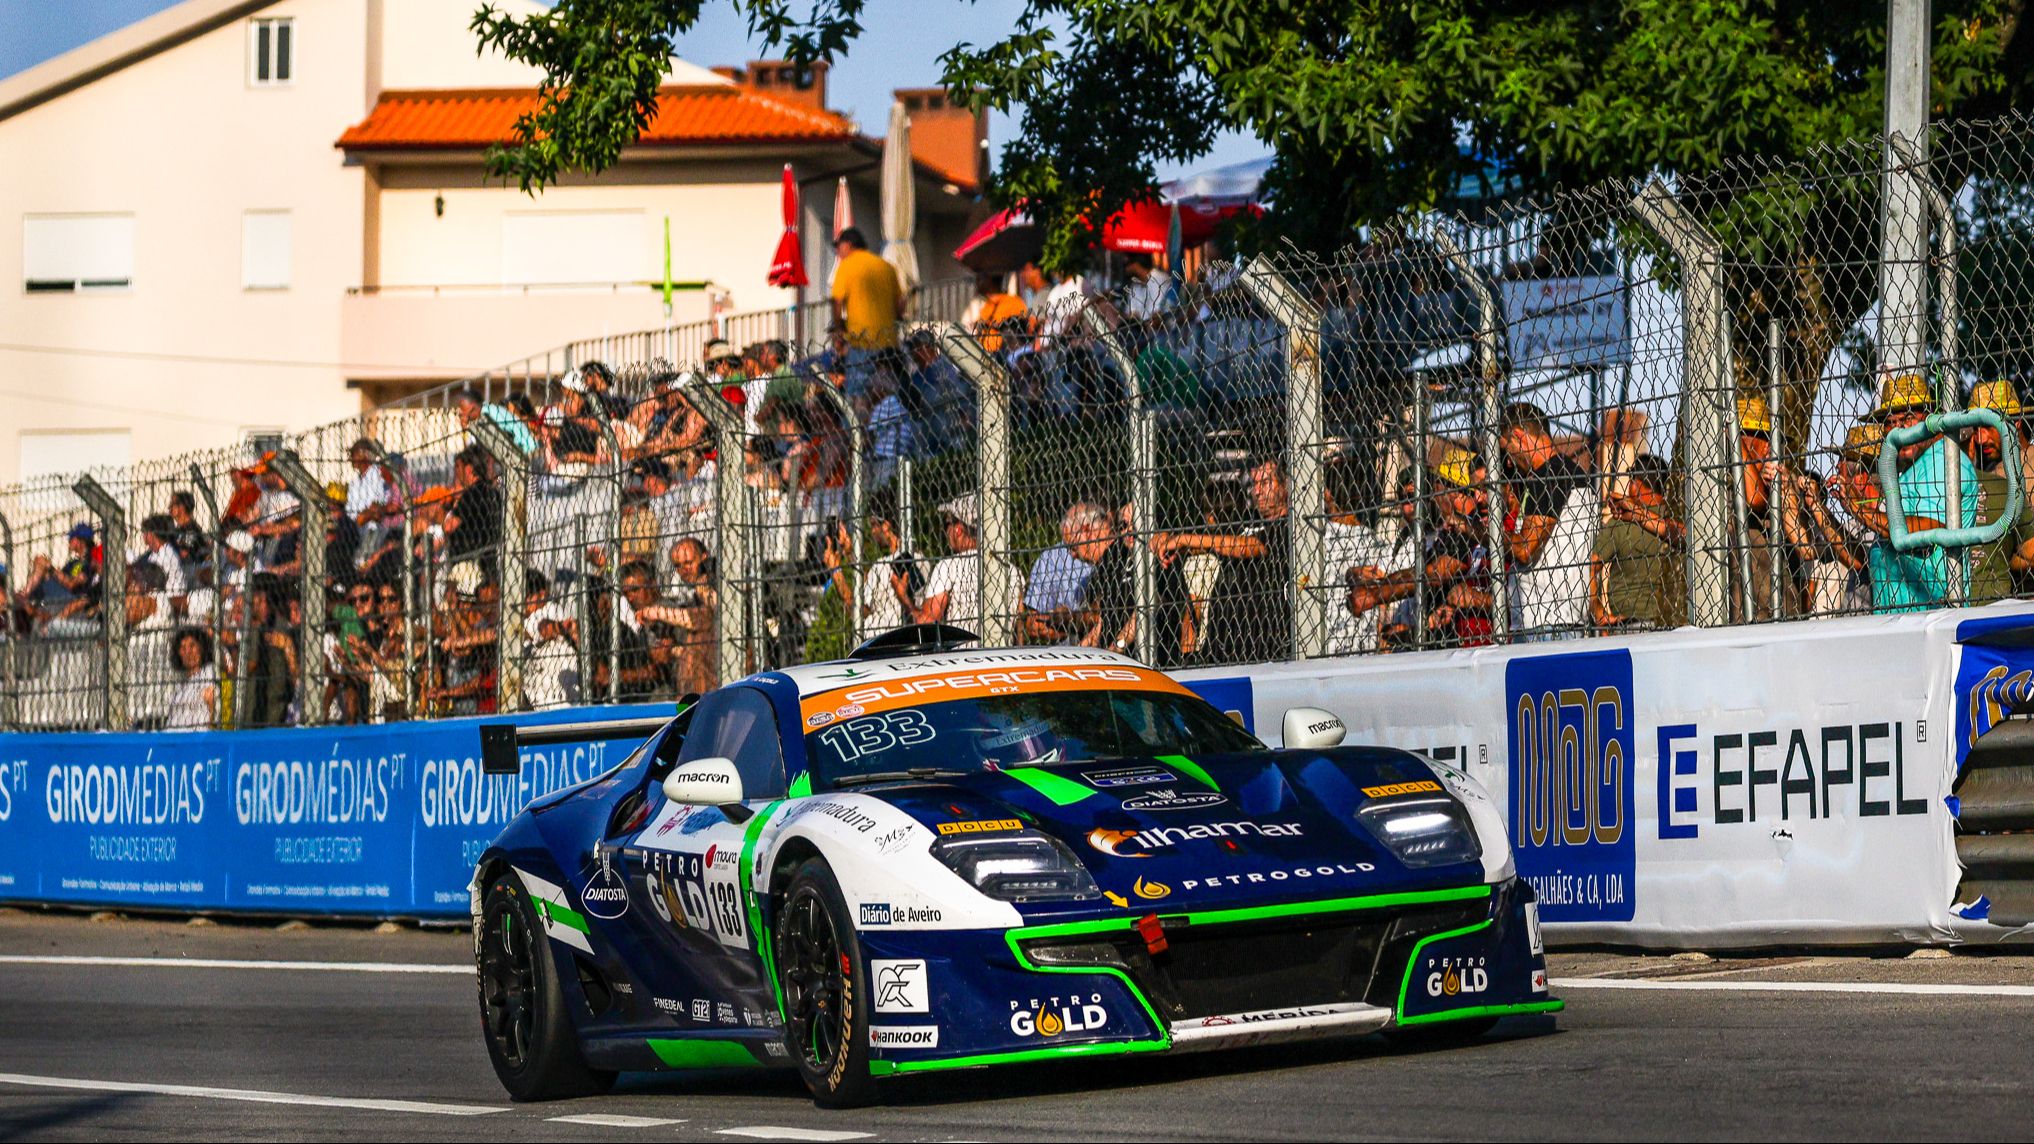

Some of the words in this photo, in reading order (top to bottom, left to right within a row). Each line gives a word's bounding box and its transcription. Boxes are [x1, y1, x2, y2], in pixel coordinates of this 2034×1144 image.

[887, 650, 1118, 672] Extremadura
[845, 668, 1142, 705] SUPERCARS
[820, 709, 937, 763] 133
[1308, 719, 1345, 735] macron
[678, 772, 730, 784] macron
[1713, 721, 1928, 824] EFAPEL
[46, 748, 204, 825] GIRODMÉDIAS
[236, 742, 388, 825] GIRODMÉDIAS
[1369, 782, 1436, 797] DOCU
[1130, 796, 1221, 808] DIATOSTA
[942, 821, 1016, 832] DOCU
[642, 850, 699, 878] PETRO
[714, 850, 737, 864] moura
[1182, 862, 1376, 891] PETROGOLD
[585, 887, 627, 901] DIATOSTA
[1521, 869, 1573, 905] GALHÃES
[1577, 877, 1584, 904] &
[1606, 873, 1624, 904] LDA
[709, 882, 743, 937] 133
[861, 906, 889, 923] Diário
[893, 906, 905, 921] de
[908, 905, 941, 922] Aveiro
[1429, 957, 1485, 968] PETRO
[1010, 993, 1102, 1011] PETRO
